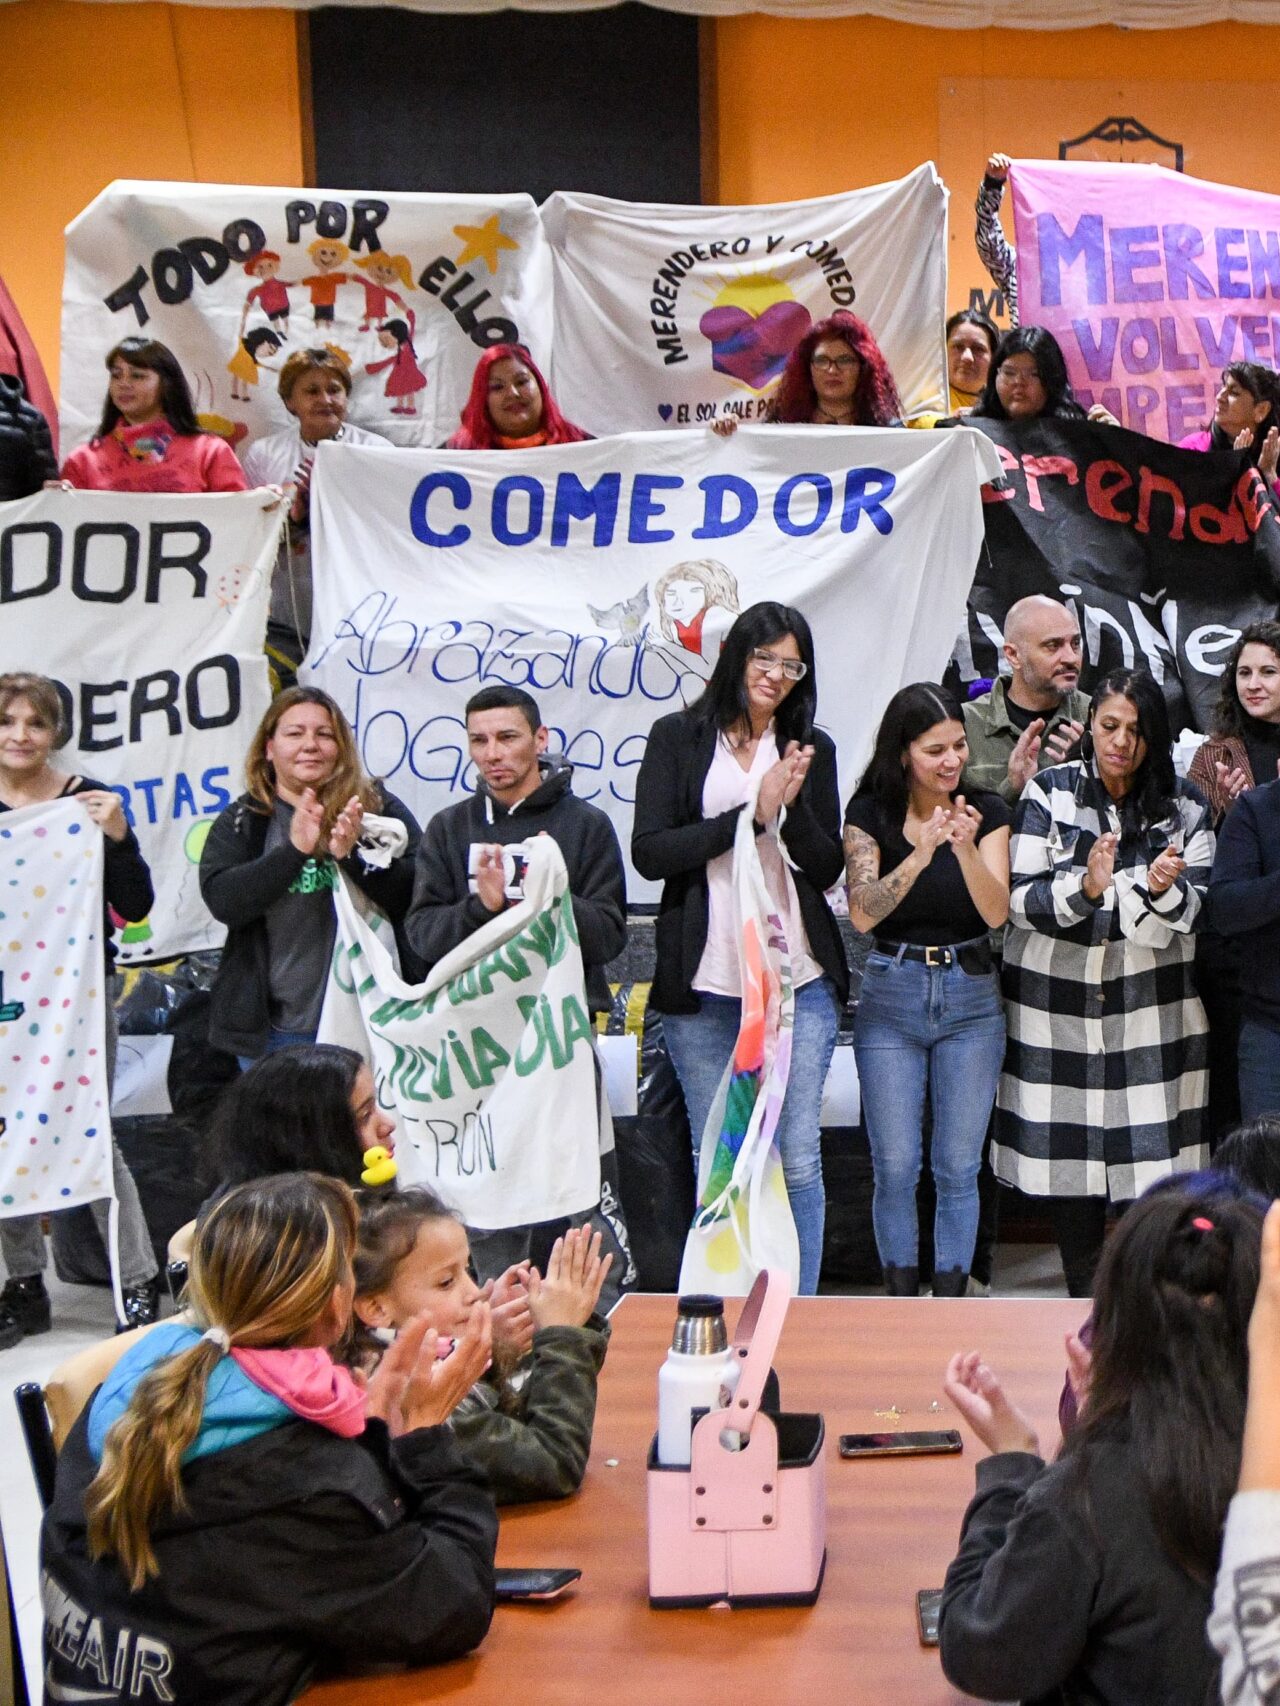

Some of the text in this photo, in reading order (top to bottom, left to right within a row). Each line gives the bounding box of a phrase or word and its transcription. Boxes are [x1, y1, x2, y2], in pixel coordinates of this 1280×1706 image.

[104, 219, 266, 327] TODO
[286, 199, 389, 253] POR
[651, 237, 751, 366] MERENDERO
[766, 235, 784, 254] Y
[677, 404, 690, 424] EL
[409, 467, 895, 548] COMEDOR
[1, 520, 211, 604] DOR
[77, 1617, 175, 1702] AIR
